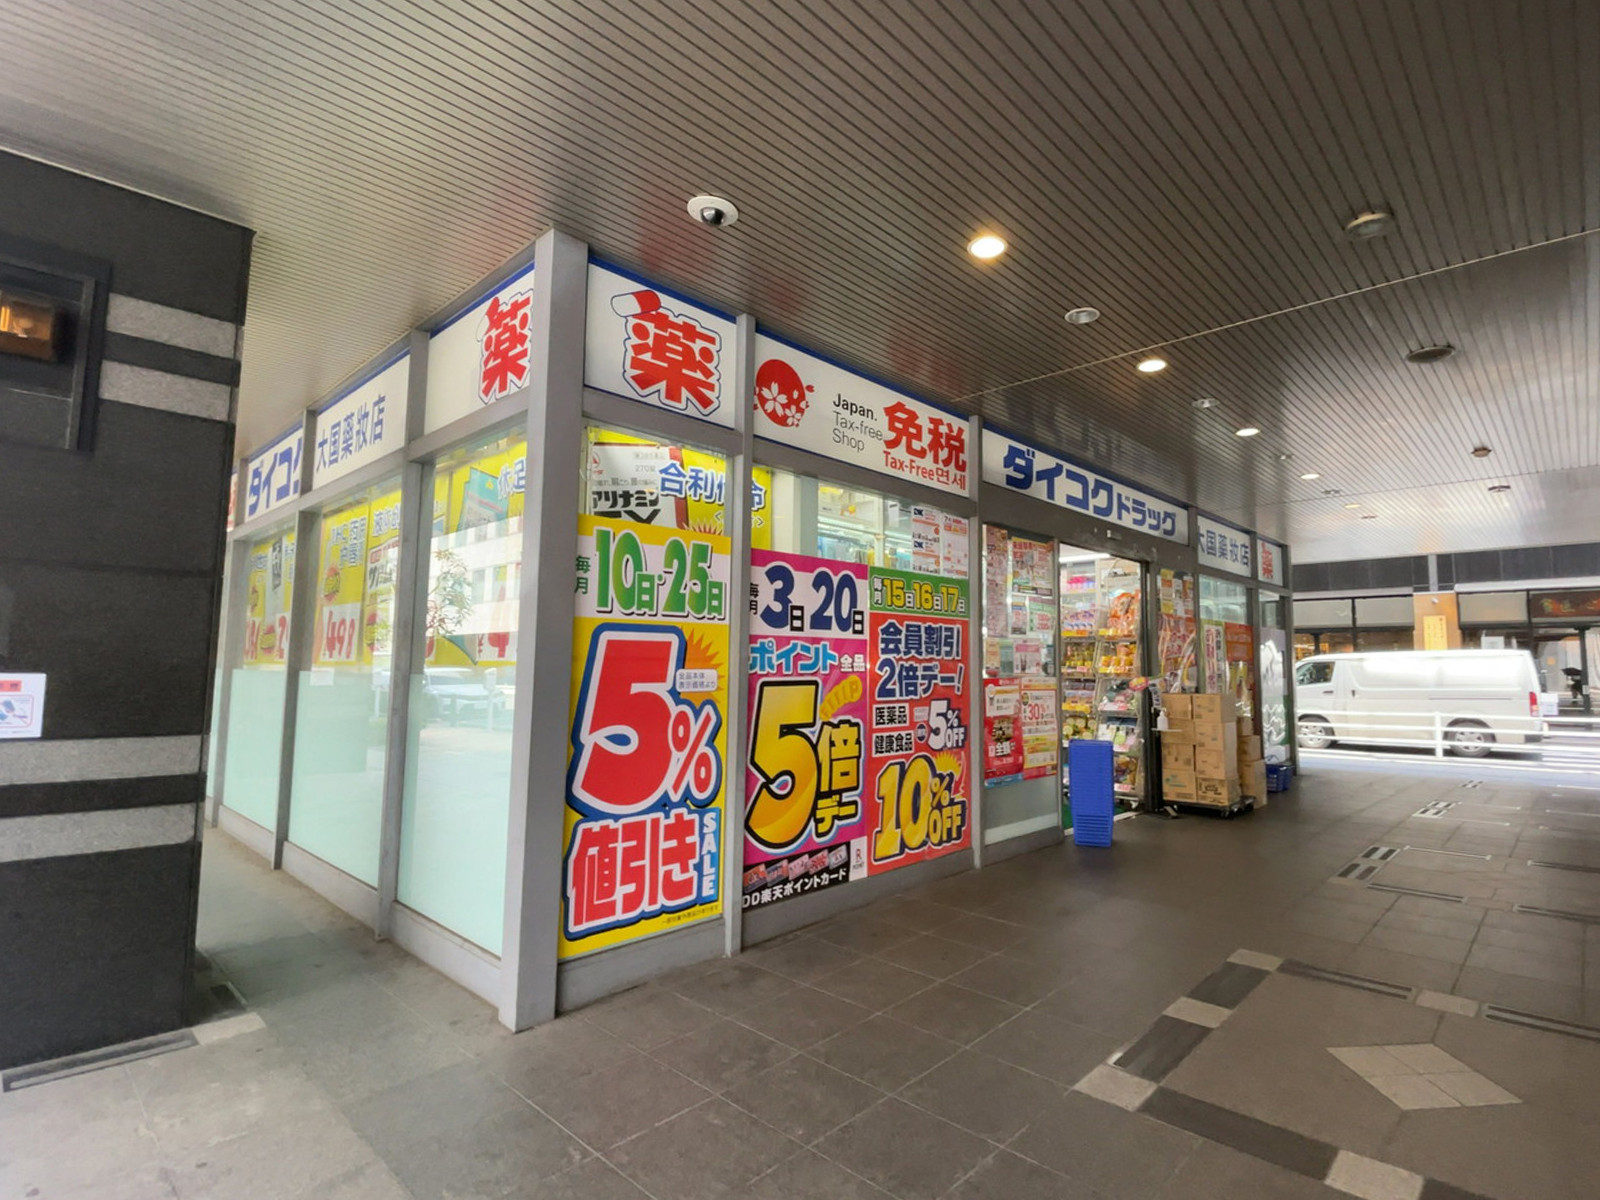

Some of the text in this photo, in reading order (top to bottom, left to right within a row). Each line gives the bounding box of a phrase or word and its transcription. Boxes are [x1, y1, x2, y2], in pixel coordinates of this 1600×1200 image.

[629, 308, 716, 410] 薬
[832, 393, 878, 422] Japan.
[832, 428, 865, 452] Shop
[833, 411, 883, 441] Tax-free
[883, 401, 967, 473] 免税
[883, 450, 934, 481] Tax-Free
[1003, 445, 1177, 537] ダイコクドラッグ
[750, 640, 838, 673] ポイント
[879, 621, 962, 661] 会員割引
[577, 636, 714, 810] 5%
[875, 705, 908, 727] 医薬品
[874, 732, 914, 755] 健康食品
[572, 812, 698, 928] 値引き
[700, 812, 717, 898] SALE
